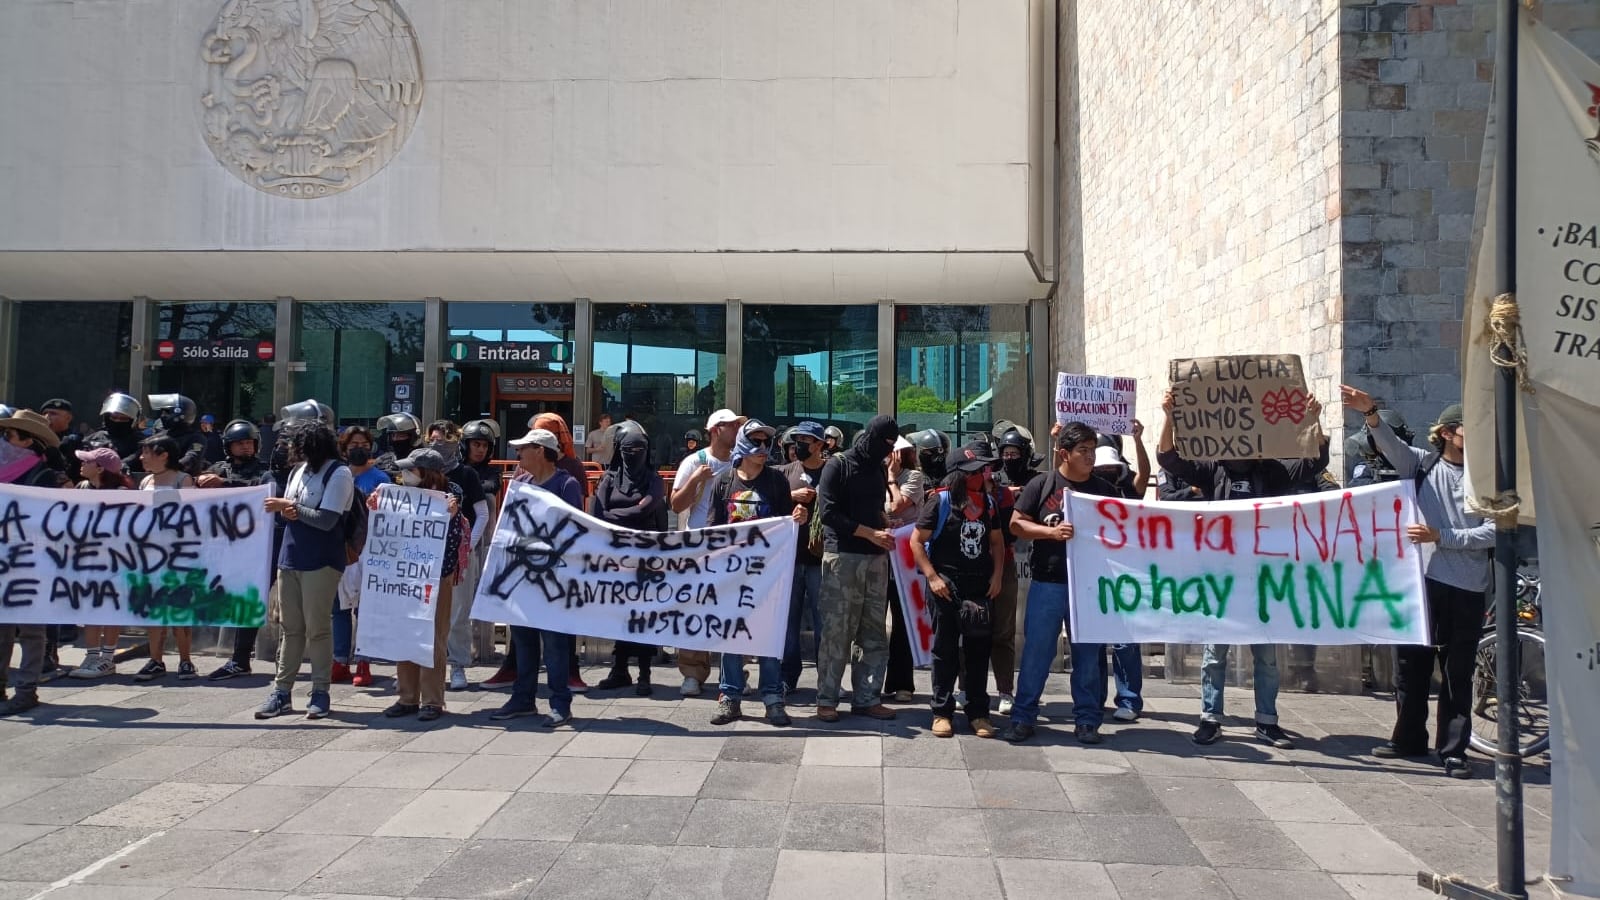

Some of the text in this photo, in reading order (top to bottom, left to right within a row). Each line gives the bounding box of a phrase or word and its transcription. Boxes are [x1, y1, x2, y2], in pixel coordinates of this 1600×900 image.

[1552, 222, 1600, 248] ¡BA
[1556, 295, 1600, 321] SIS
[183, 346, 249, 358] Sólo Salida
[478, 346, 540, 360] Entrada
[1215, 358, 1290, 381] LUCHA
[1091, 390, 1105, 402] CON
[1110, 392, 1124, 403] TUS
[1097, 378, 1110, 389] DEL
[1113, 378, 1134, 392] INAH
[1171, 384, 1253, 408] ES UNA
[1171, 406, 1255, 433] FUIMOS
[1175, 434, 1263, 458] TODXS!
[378, 488, 431, 516] INAH
[41, 500, 201, 543] CULTURA
[208, 501, 256, 541] NO
[1095, 499, 1174, 550] Sin
[1253, 492, 1405, 565] ENAH
[369, 540, 399, 558] LXS
[609, 526, 770, 550] ESCUELA
[45, 541, 207, 573] VENDE
[581, 554, 766, 575] NACIONAL DE
[396, 561, 431, 579] SON
[0, 578, 40, 607] E
[50, 576, 120, 610] AMA
[738, 584, 756, 608] E
[1098, 561, 1412, 630] no hay MNA
[628, 609, 752, 640] HISTORIA
